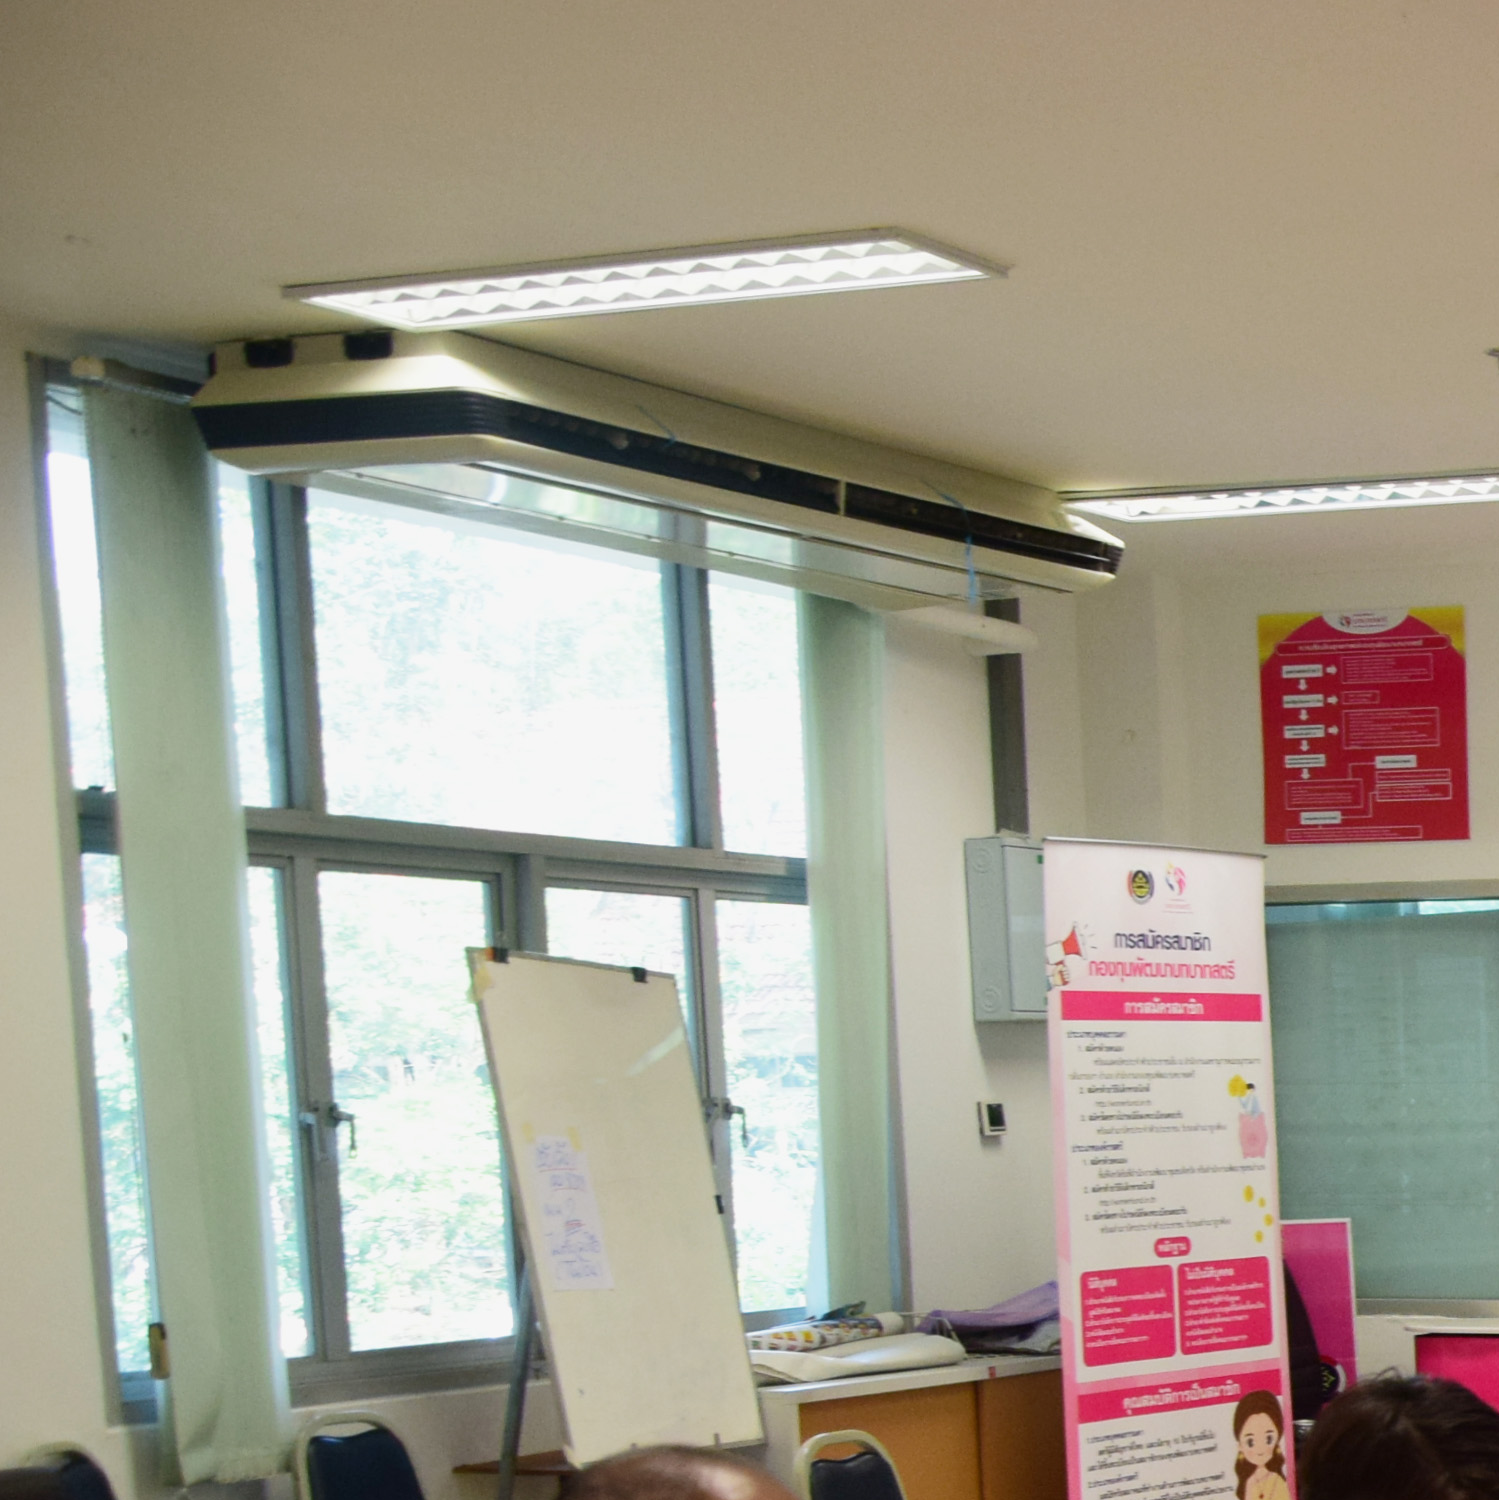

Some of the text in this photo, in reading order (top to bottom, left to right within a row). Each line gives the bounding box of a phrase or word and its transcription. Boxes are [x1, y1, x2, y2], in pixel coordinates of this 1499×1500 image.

[1114, 930, 1212, 952] การสมัครสมาชิก
[1088, 957, 1236, 983] กองทุนพัฒนาบทบาทสตรี
[1124, 997, 1205, 1015] การสมัครสมาชิก
[1122, 1379, 1241, 1415] คุณสมบัติการเป็นสมาชิก
